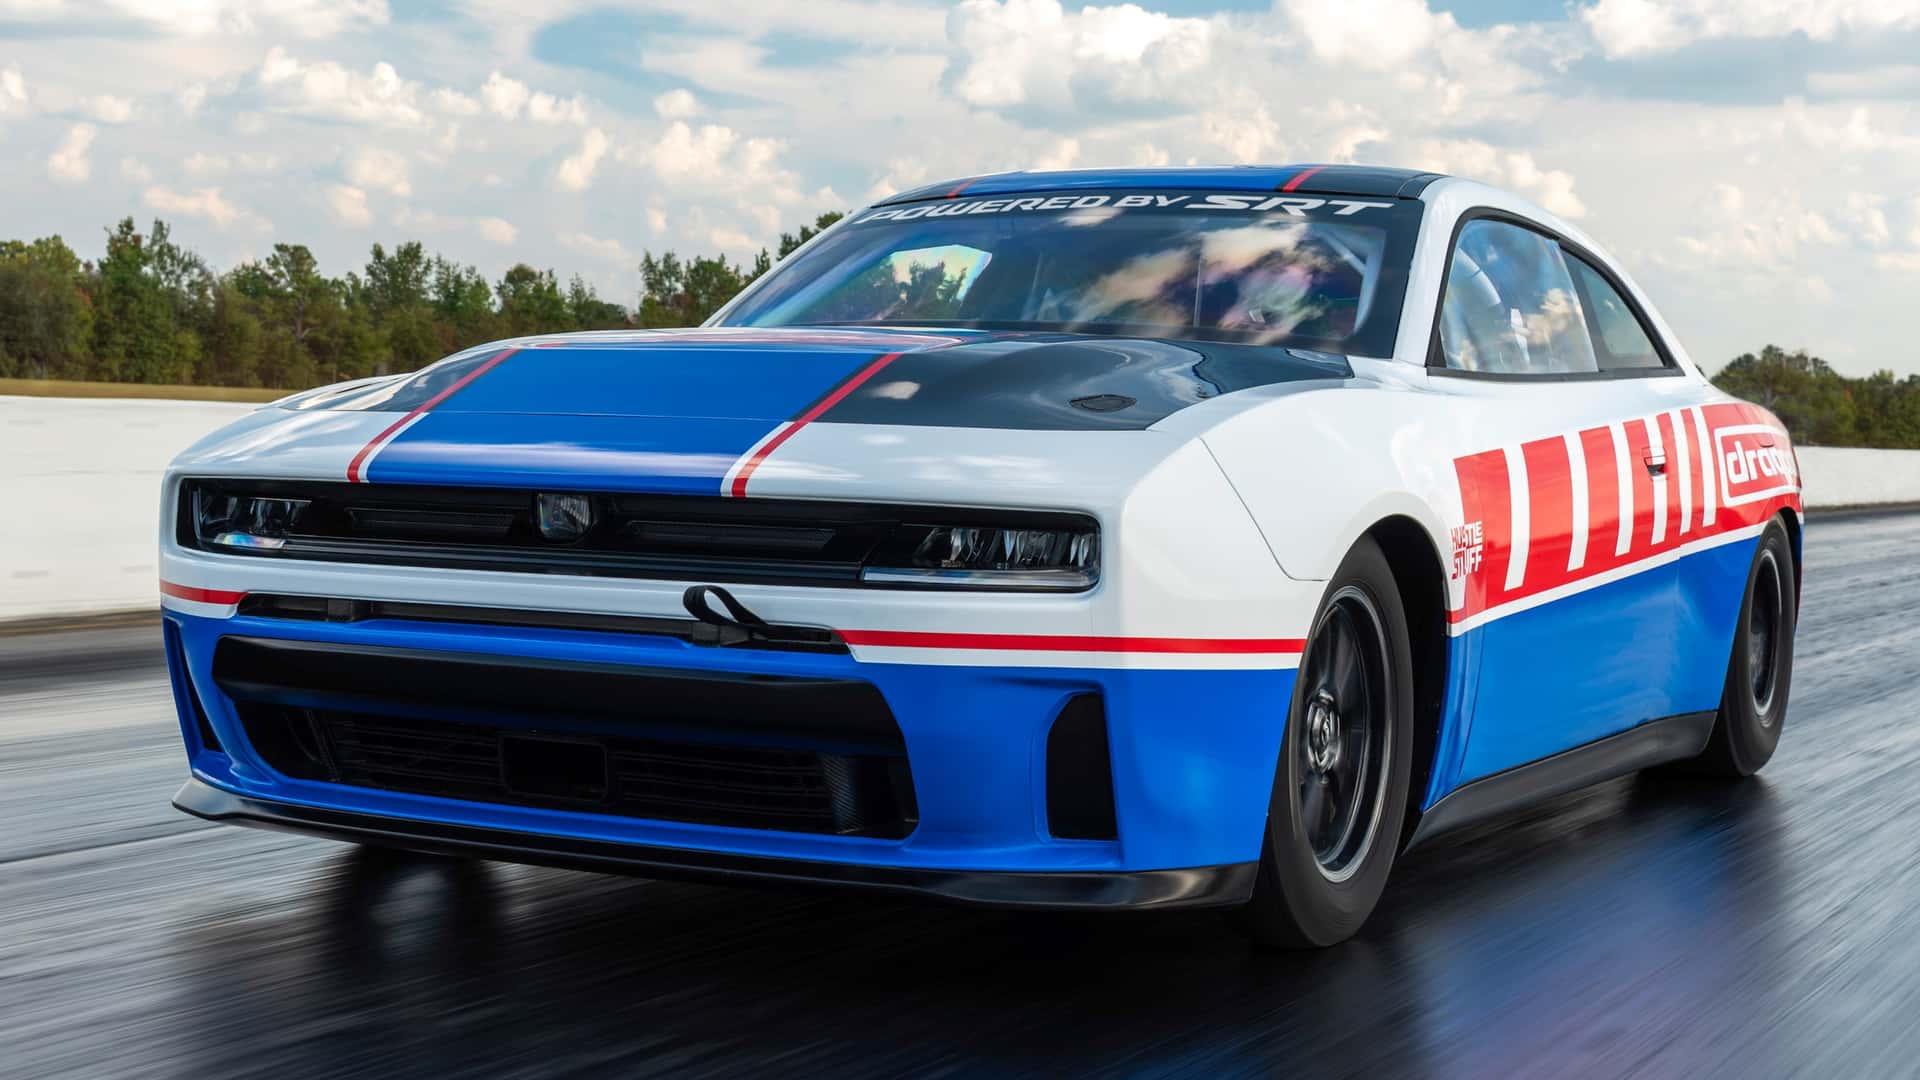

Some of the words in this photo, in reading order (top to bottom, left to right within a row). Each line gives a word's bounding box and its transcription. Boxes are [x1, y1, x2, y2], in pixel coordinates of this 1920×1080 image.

[852, 195, 1111, 224] POWERED
[1112, 195, 1192, 208] BY
[1184, 194, 1395, 217] SRT
[1451, 543, 1483, 580] STUFF
